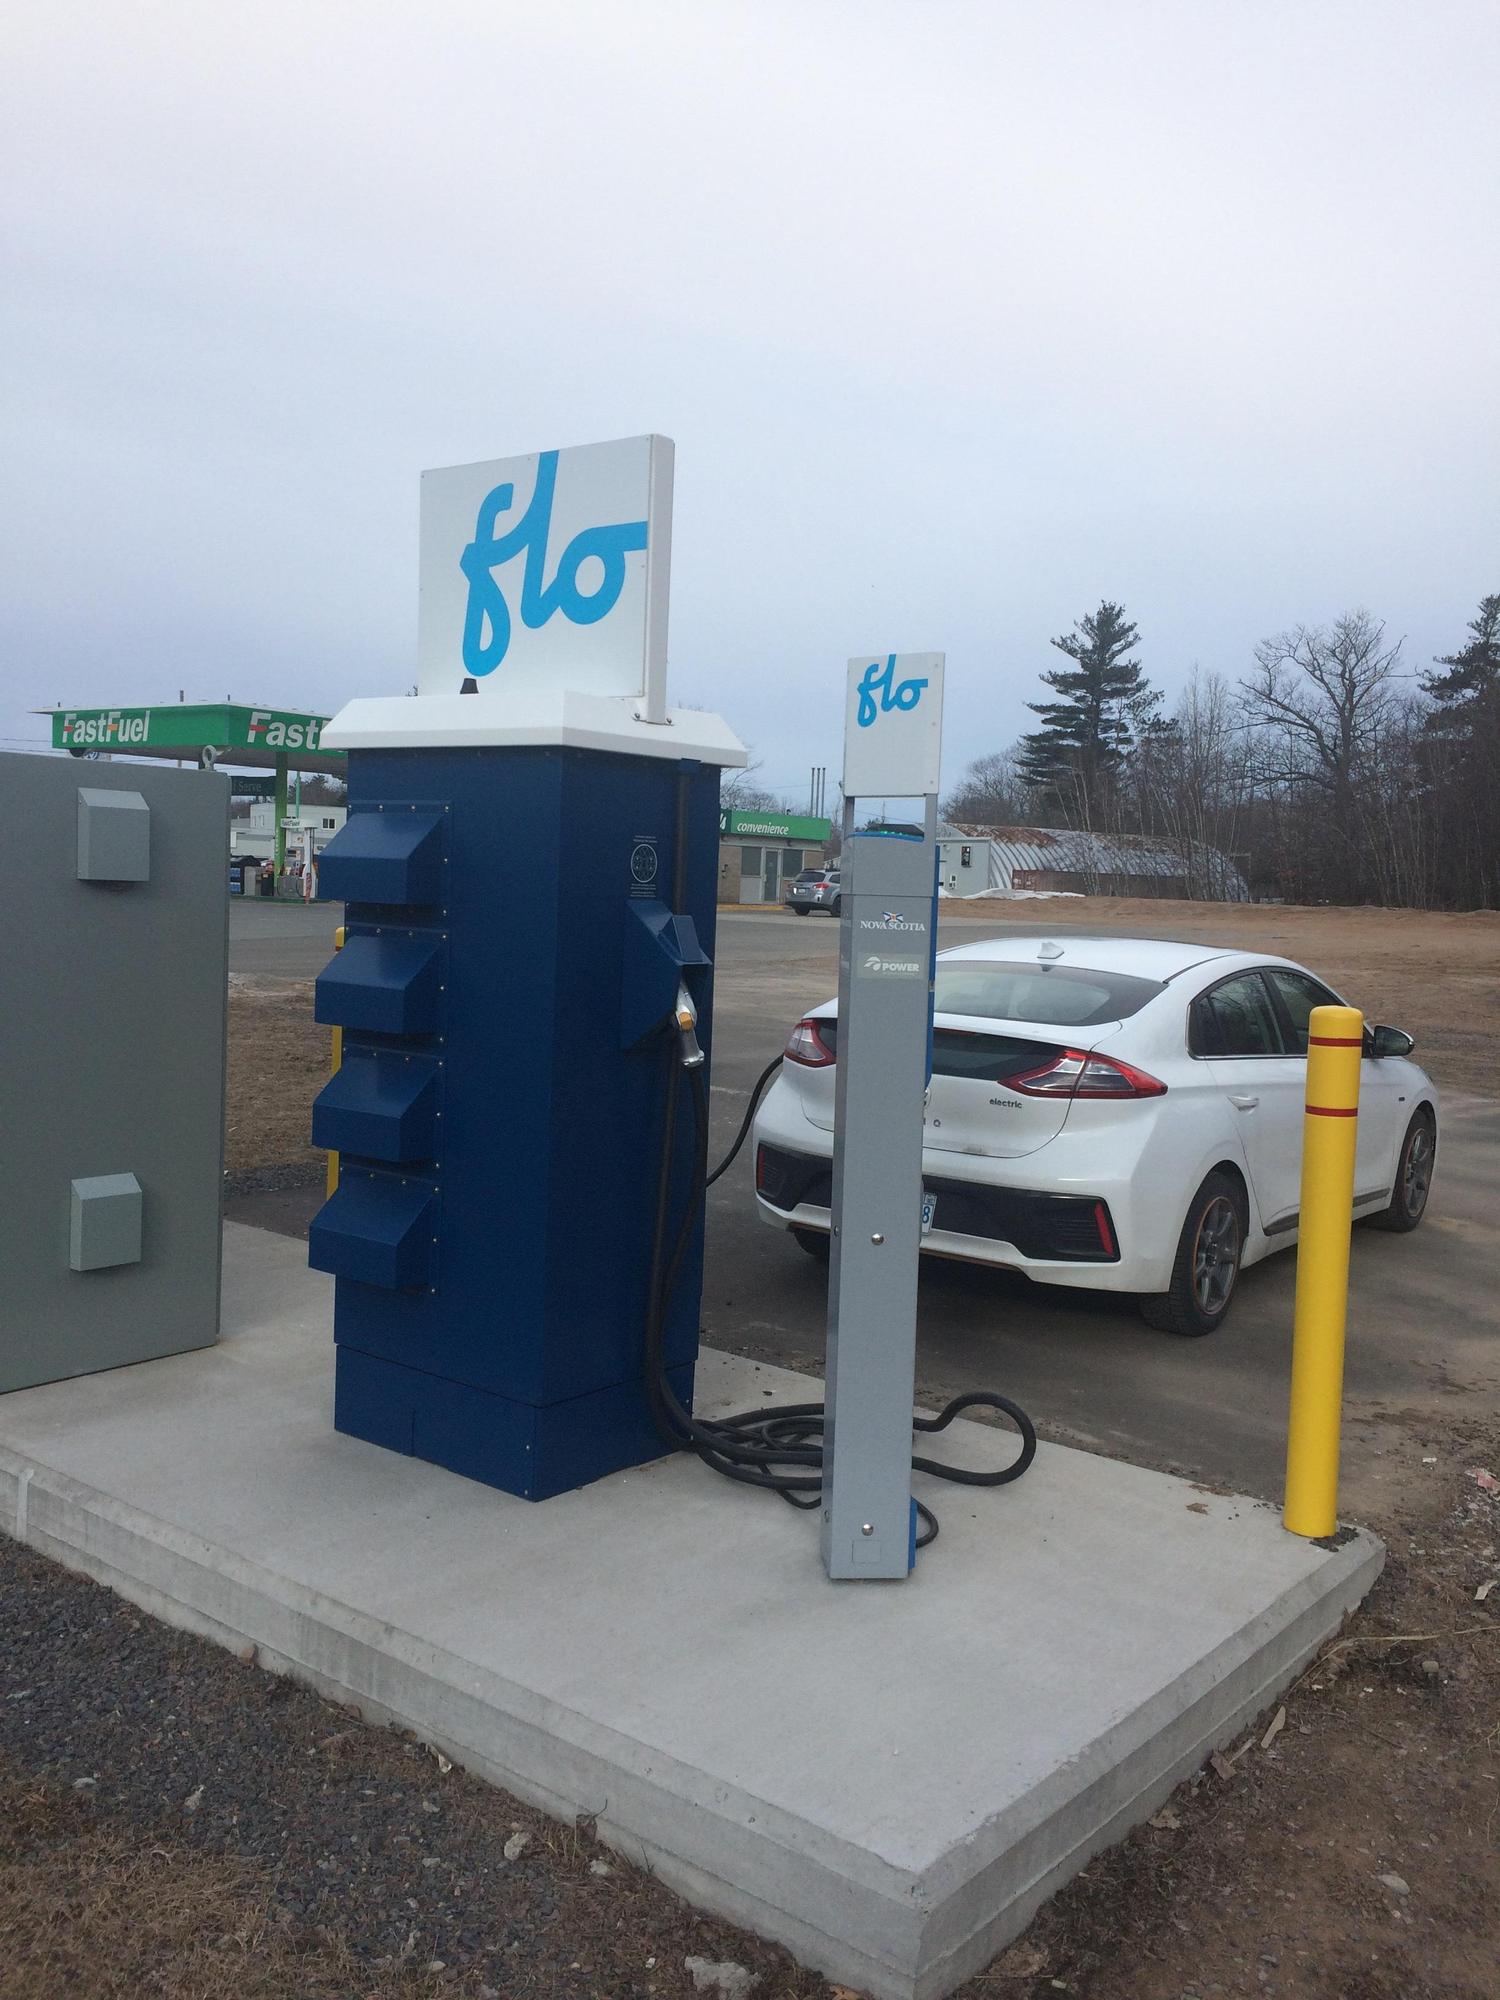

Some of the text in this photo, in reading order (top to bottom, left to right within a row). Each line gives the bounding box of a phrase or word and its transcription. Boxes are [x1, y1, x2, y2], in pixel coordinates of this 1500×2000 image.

[459, 450, 648, 677] flo
[857, 653, 928, 727] flo
[62, 711, 150, 743] FastFuel
[247, 711, 330, 750] Fast
[737, 822, 789, 835] convenience
[860, 920, 926, 931] NOVA SCOTIA
[882, 963, 920, 972] POWER
[989, 1098, 1023, 1109] electric
